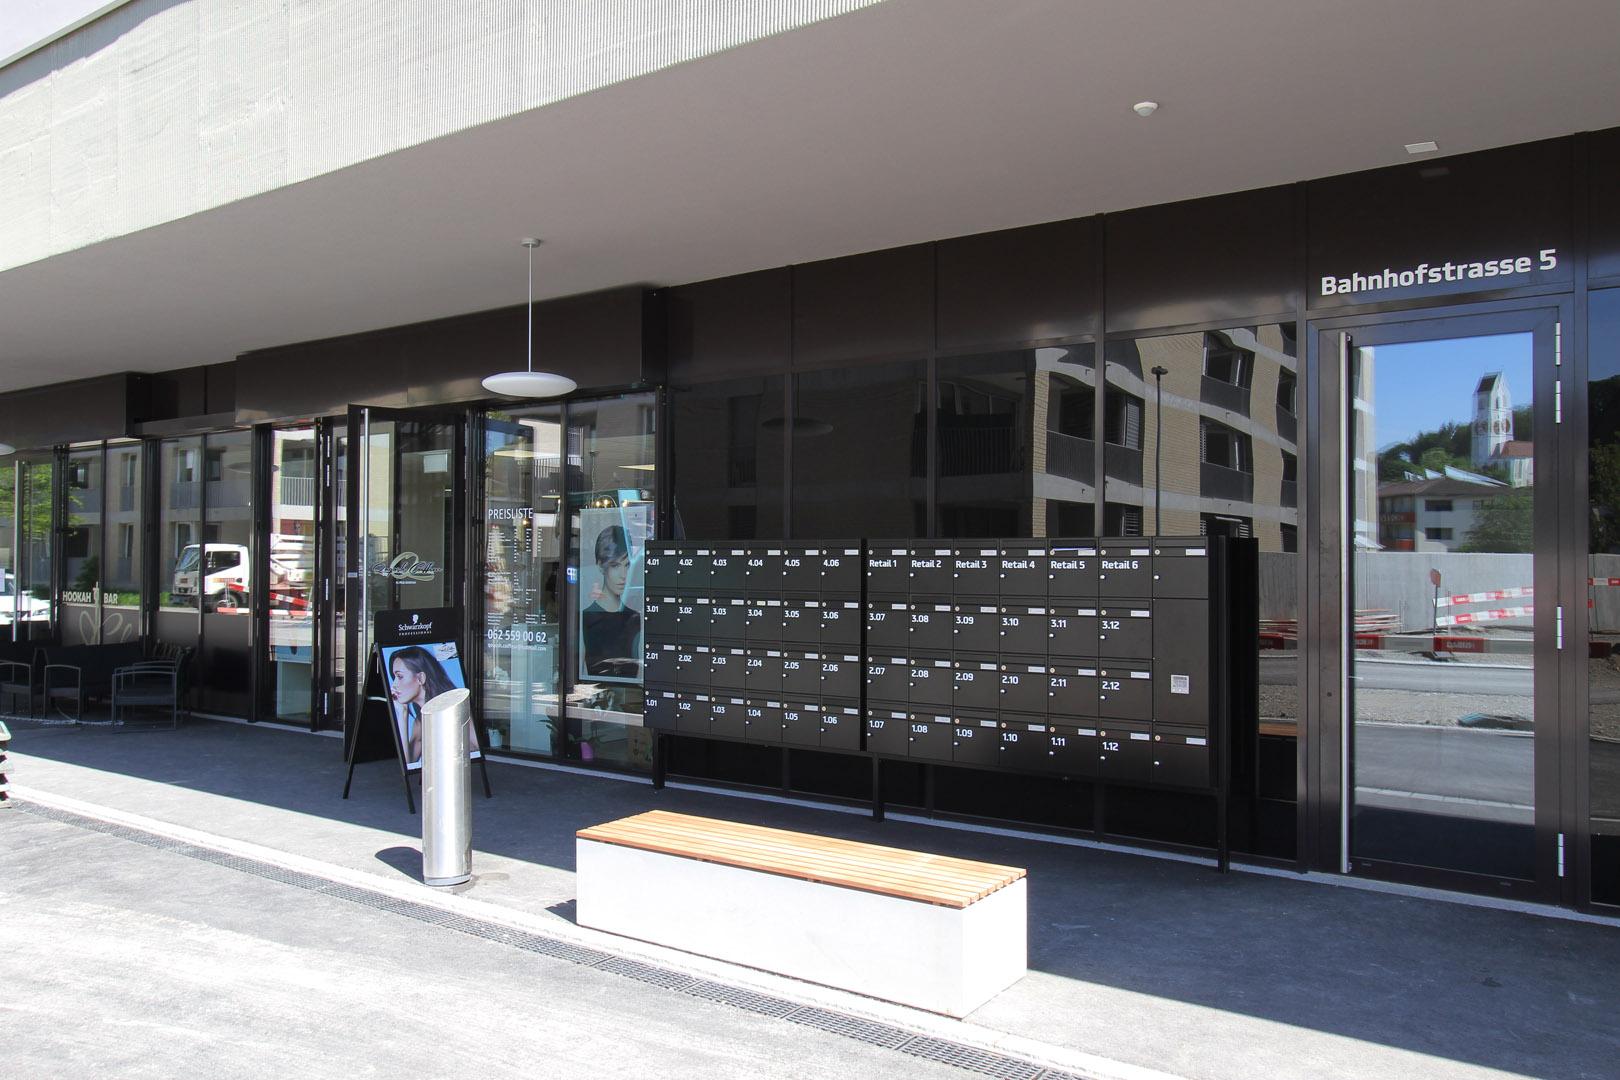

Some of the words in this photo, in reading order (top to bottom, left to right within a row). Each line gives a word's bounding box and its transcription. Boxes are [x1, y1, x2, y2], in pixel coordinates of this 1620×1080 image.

[1321, 256, 1531, 296] Bahnhofstrasse
[1539, 249, 1557, 271] 5
[488, 507, 533, 520] PREISLISTE
[823, 559, 839, 567] 4.06
[956, 560, 980, 568] Retail
[982, 560, 987, 568] 3
[1002, 560, 1028, 568] Retail
[1051, 560, 1077, 569] Retail
[1079, 561, 1085, 569] 5
[1102, 560, 1130, 569] Retail
[1132, 561, 1138, 569] 6
[62, 591, 92, 602] HOOKAH
[103, 593, 118, 604] BAR
[785, 610, 799, 618] 3.05
[823, 611, 838, 619] 3.06
[869, 613, 885, 621] 3.07
[912, 615, 929, 623] 3.08
[956, 616, 974, 624] 3.09
[1002, 618, 1019, 626] 3.10
[398, 622, 432, 631] Schwarzkopf
[1051, 619, 1066, 628] 3.11
[1102, 621, 1119, 629] 3.12
[487, 629, 503, 640] 062
[505, 630, 520, 641] 559
[522, 631, 534, 642] 00
[535, 632, 547, 643] 62
[748, 659, 762, 667] 2.04
[823, 664, 838, 672] 2.06
[869, 667, 885, 675] 2.07
[912, 669, 929, 678] 2.08
[956, 673, 973, 681] 2.09
[1002, 675, 1018, 684] 2.10
[1051, 678, 1066, 687] 2.11
[1102, 681, 1120, 690] 2.12
[748, 709, 761, 717] 1.04
[823, 716, 837, 724] 1.06
[869, 720, 884, 728] 1.07
[912, 725, 928, 733] 1.08
[956, 729, 972, 737] 1.09
[1003, 733, 1017, 742] 1.10
[1051, 737, 1065, 746] 1.11
[1103, 742, 1118, 751] 1.12
